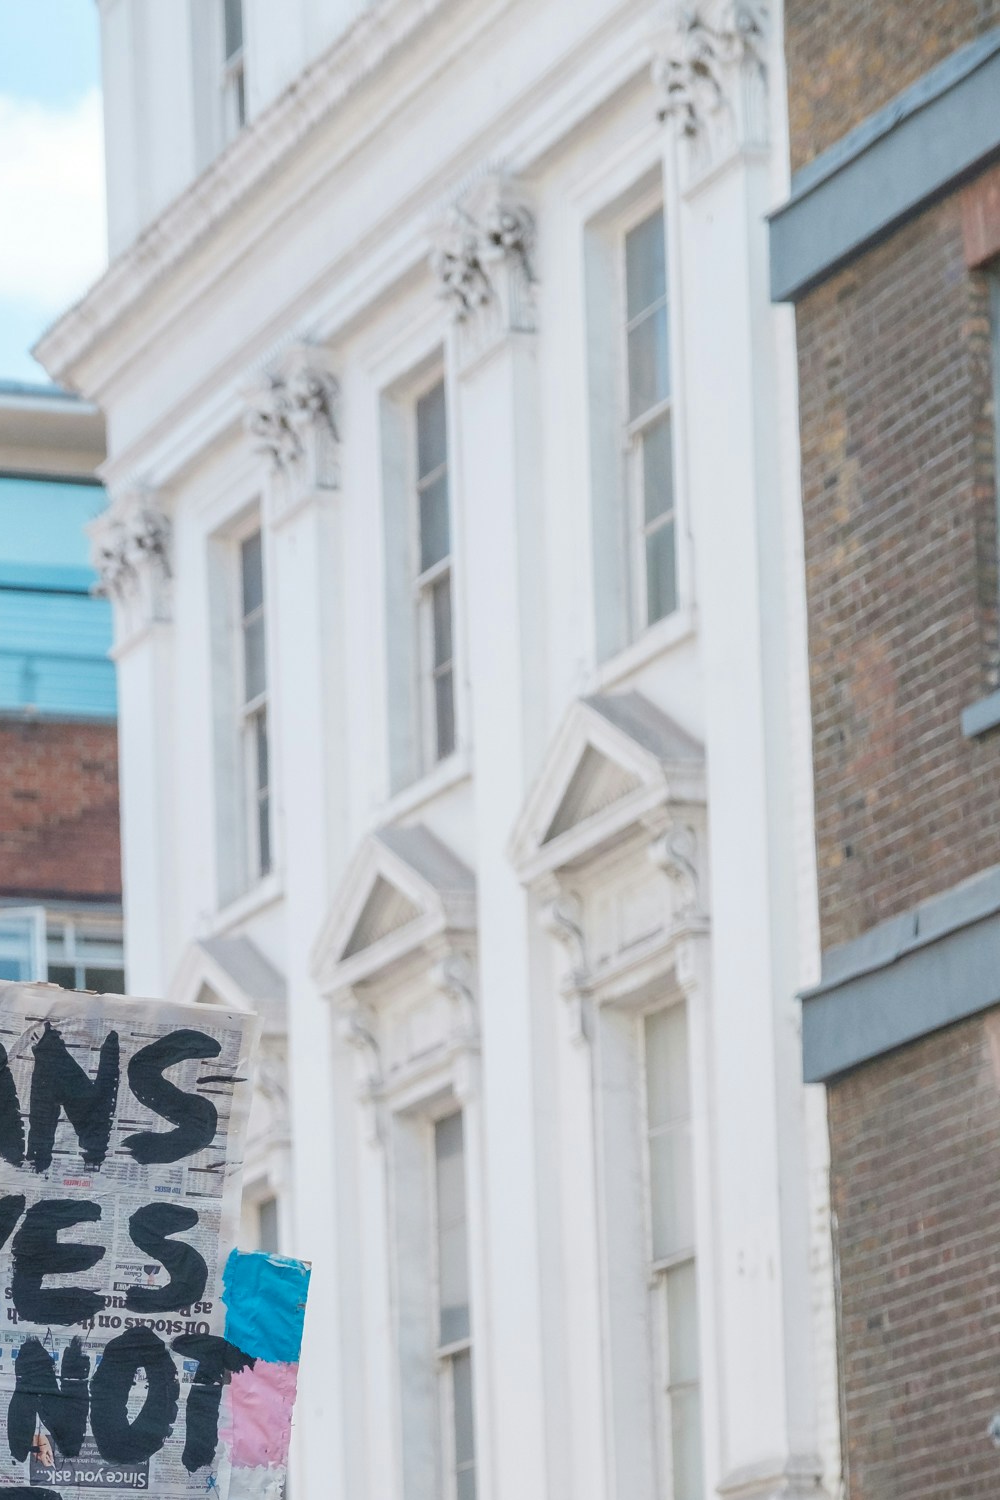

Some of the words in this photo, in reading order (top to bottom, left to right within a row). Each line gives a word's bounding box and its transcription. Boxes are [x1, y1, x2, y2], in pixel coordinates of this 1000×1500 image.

[99, 1316, 121, 1329] on
[8, 1326, 256, 1472] NOT
[74, 1467, 105, 1483] you
[105, 1470, 146, 1488] Since
